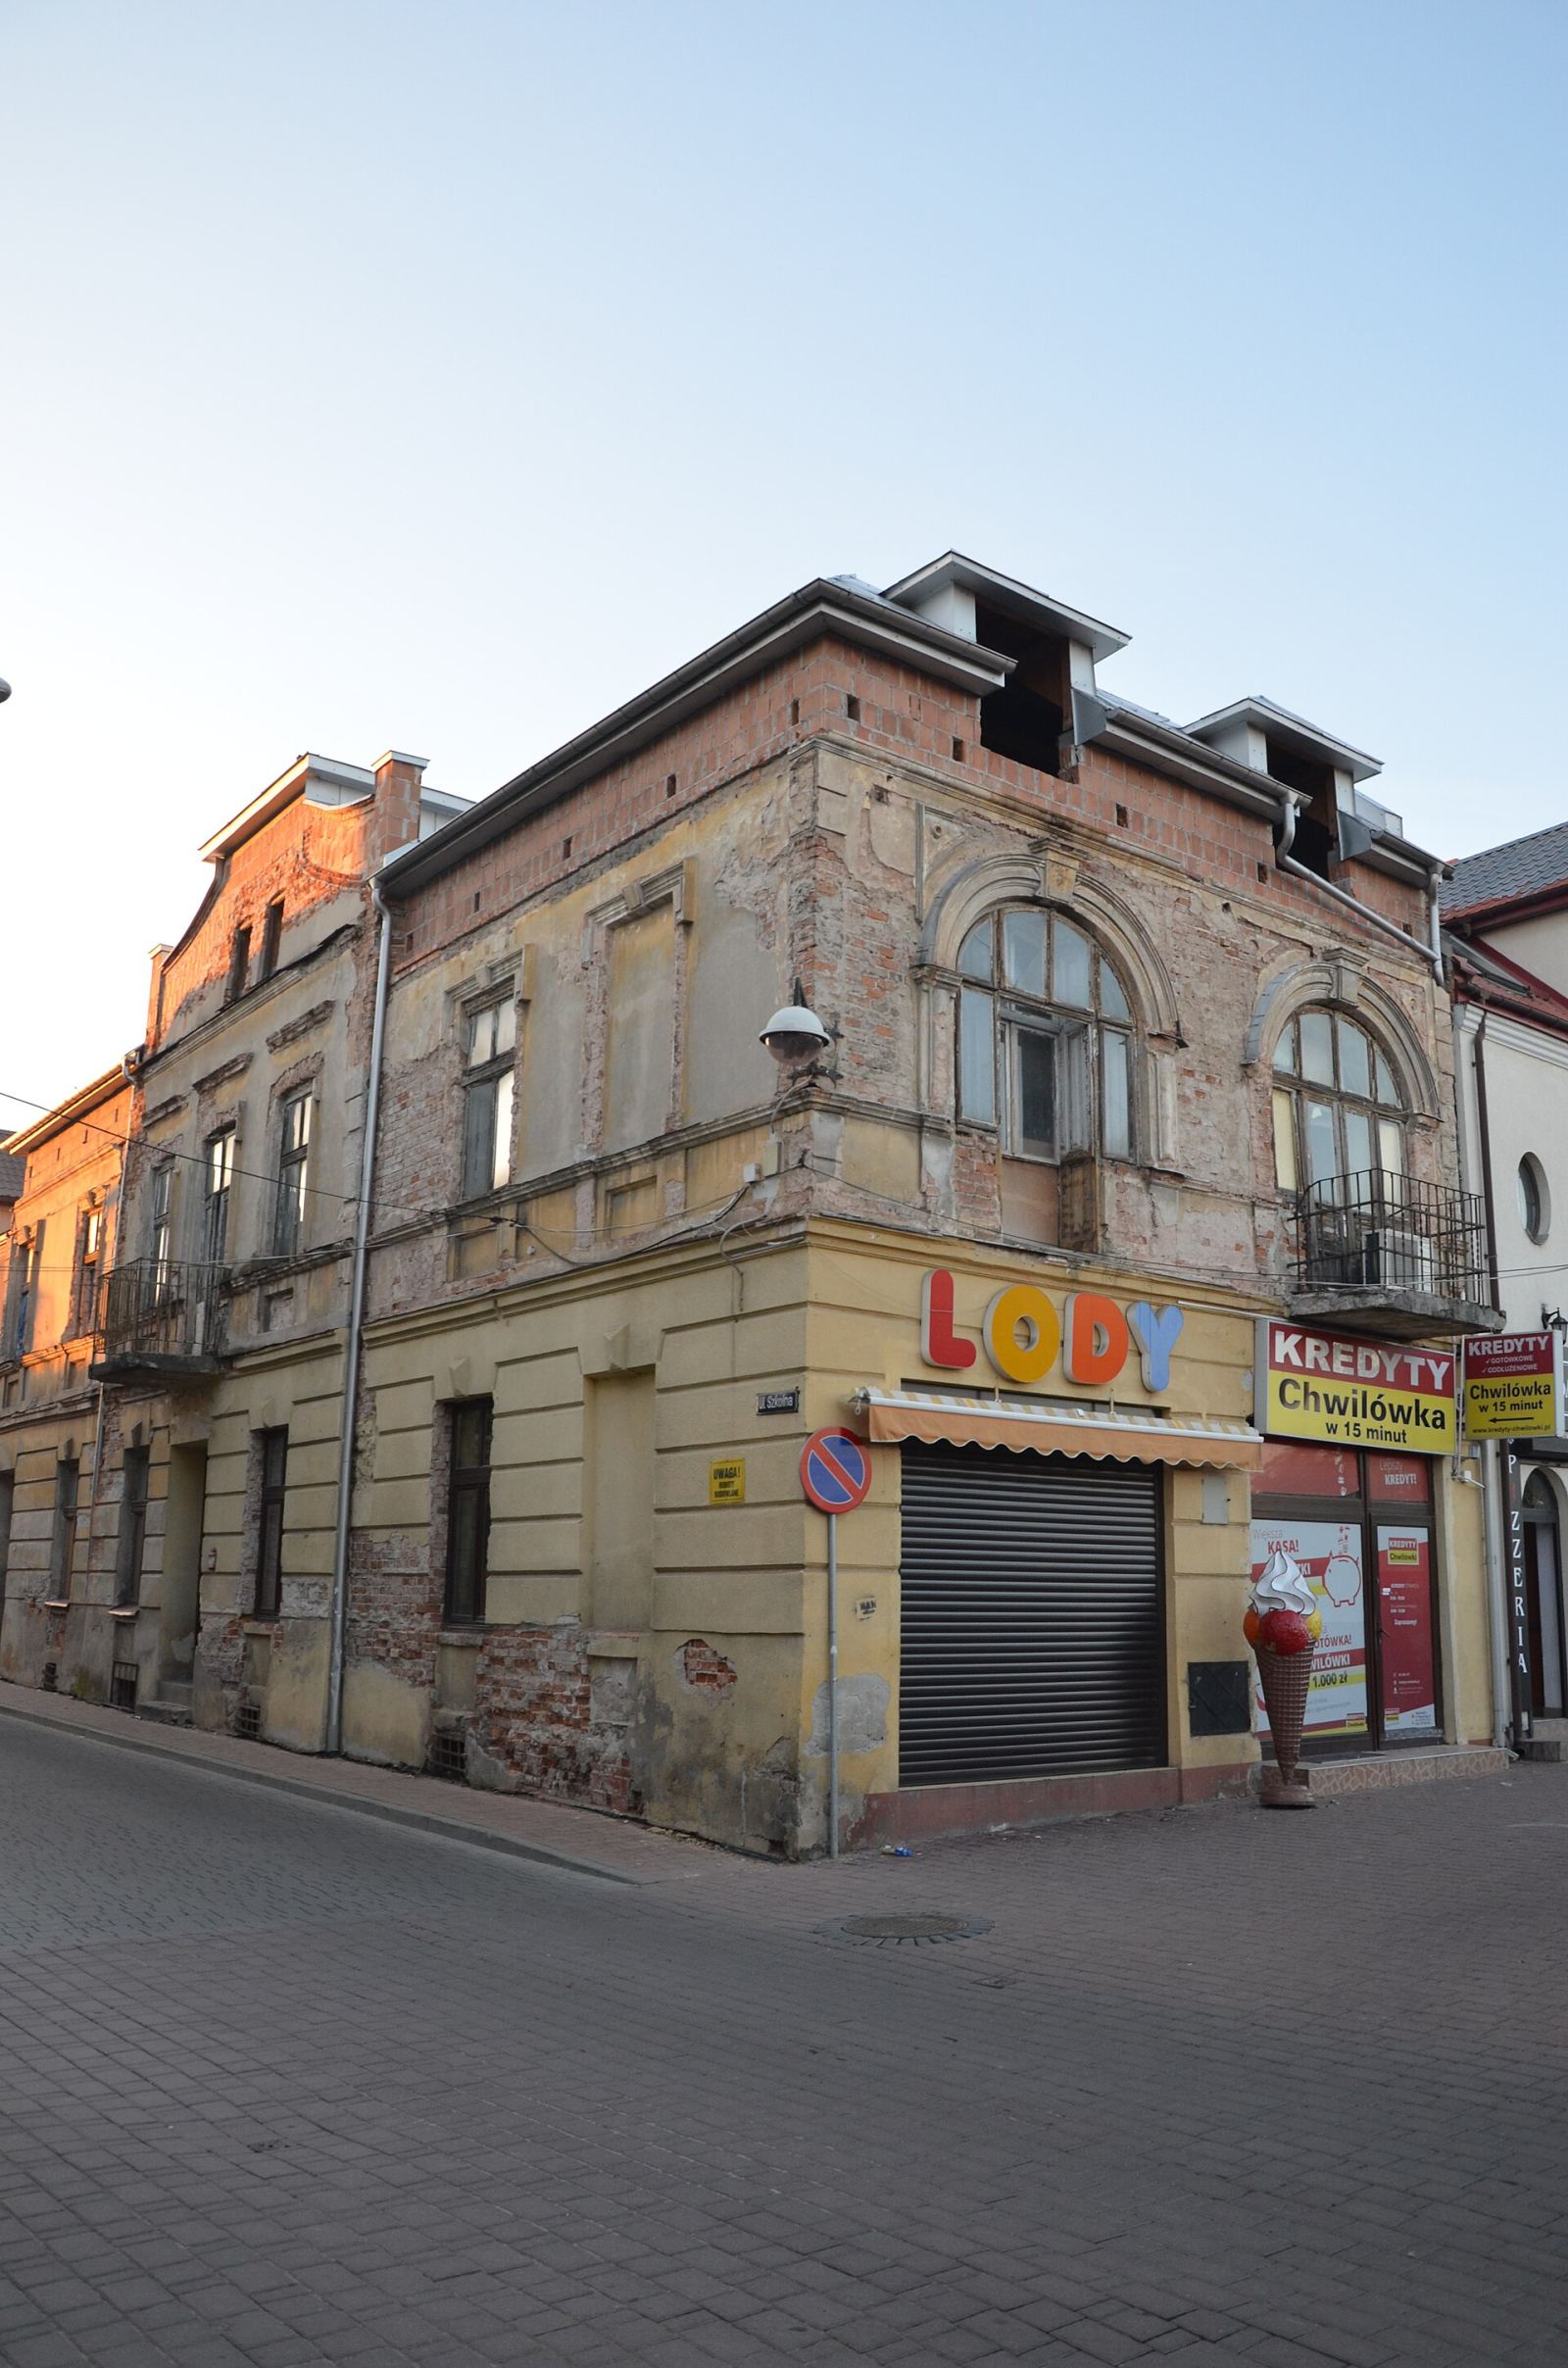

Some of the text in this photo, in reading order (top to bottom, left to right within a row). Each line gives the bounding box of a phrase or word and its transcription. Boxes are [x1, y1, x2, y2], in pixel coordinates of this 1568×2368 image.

[921, 1268, 1184, 1392] LODY
[1468, 1336, 1549, 1357] KREDYTY
[1274, 1330, 1450, 1391] KREDYTY
[1470, 1381, 1551, 1400] Chwilówka
[1279, 1378, 1446, 1430] Chwilówka
[1492, 1402, 1506, 1412] 15
[1509, 1400, 1544, 1411] minut
[1326, 1421, 1407, 1444] w 15 minut
[1384, 1473, 1417, 1486] KREDYT!
[1267, 1540, 1299, 1554] KASA!
[1314, 1634, 1352, 1649] OTÓWKA!
[1312, 1670, 1348, 1688] 1.000 zł
